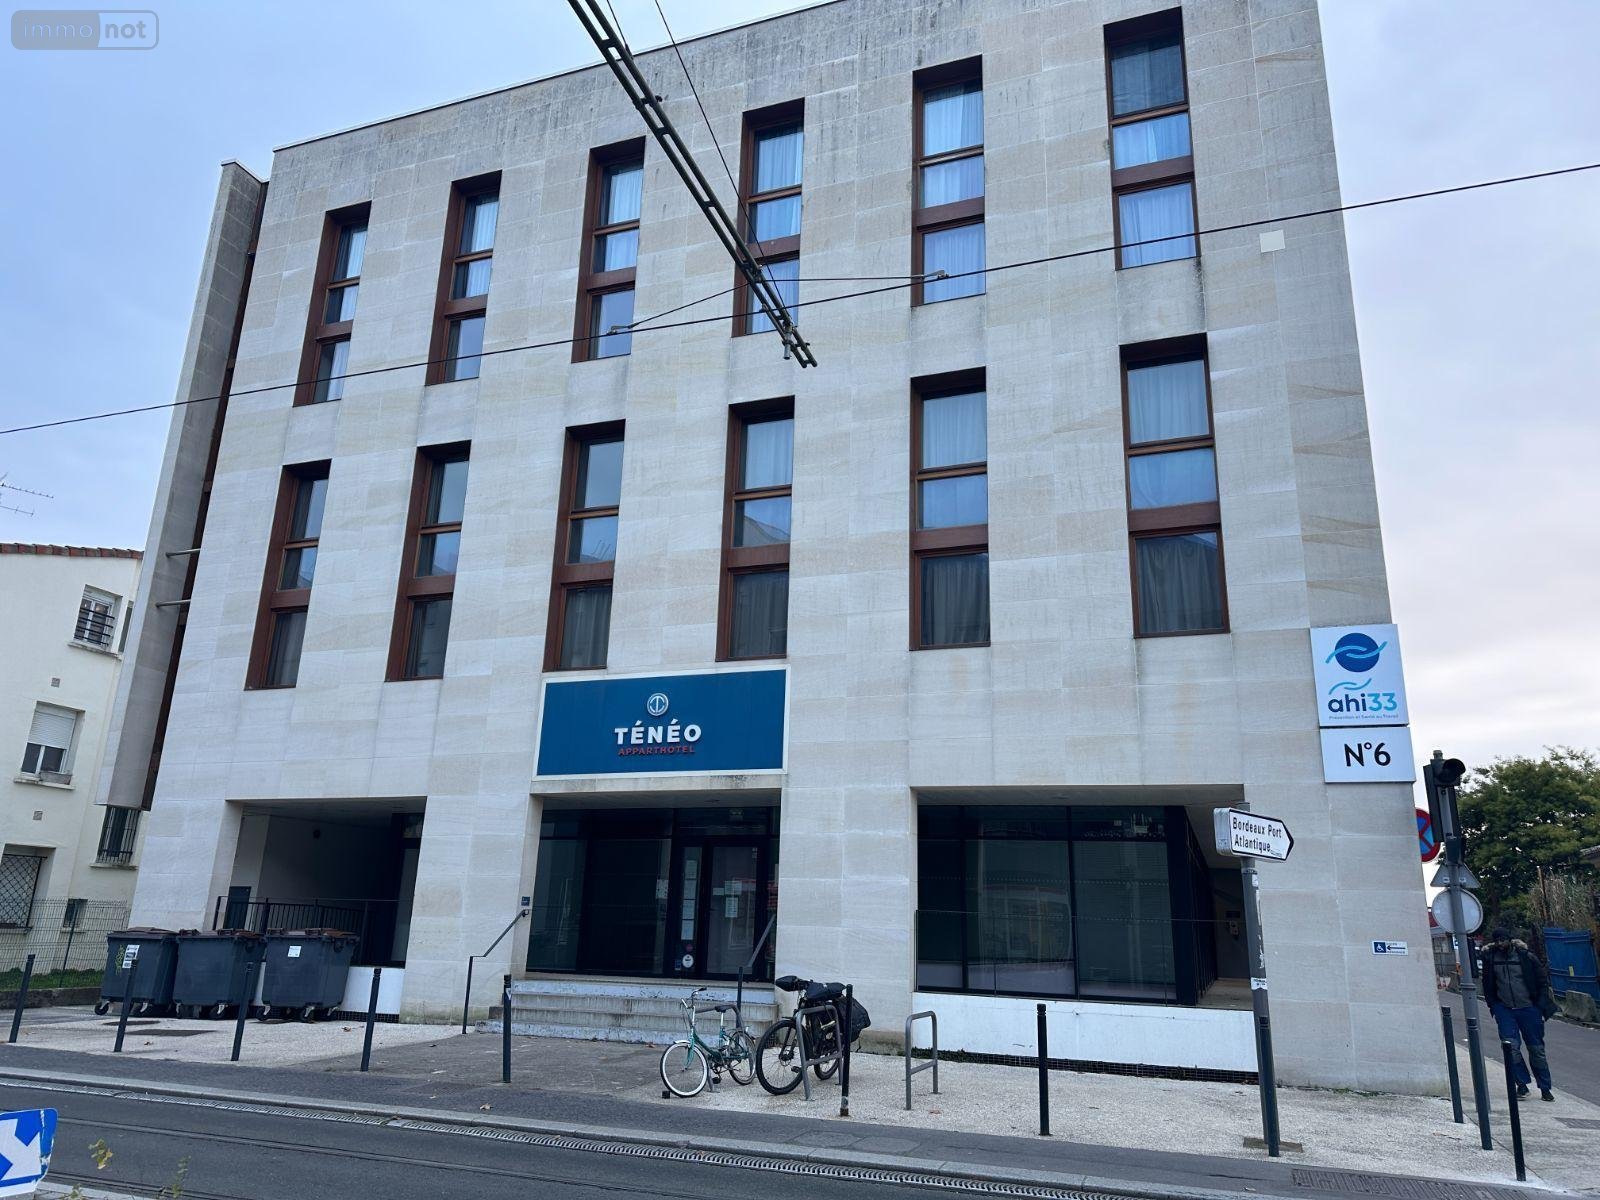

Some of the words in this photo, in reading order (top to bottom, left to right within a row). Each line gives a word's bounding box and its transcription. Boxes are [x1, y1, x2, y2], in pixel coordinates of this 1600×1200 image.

[1328, 692, 1398, 713] ahi33
[614, 718, 702, 745] TÉNÉO
[618, 745, 696, 756] APPARTHOTEL
[1232, 817, 1266, 835] Bordeaux
[1267, 824, 1282, 839] Port
[1234, 834, 1271, 853] Atlantique
